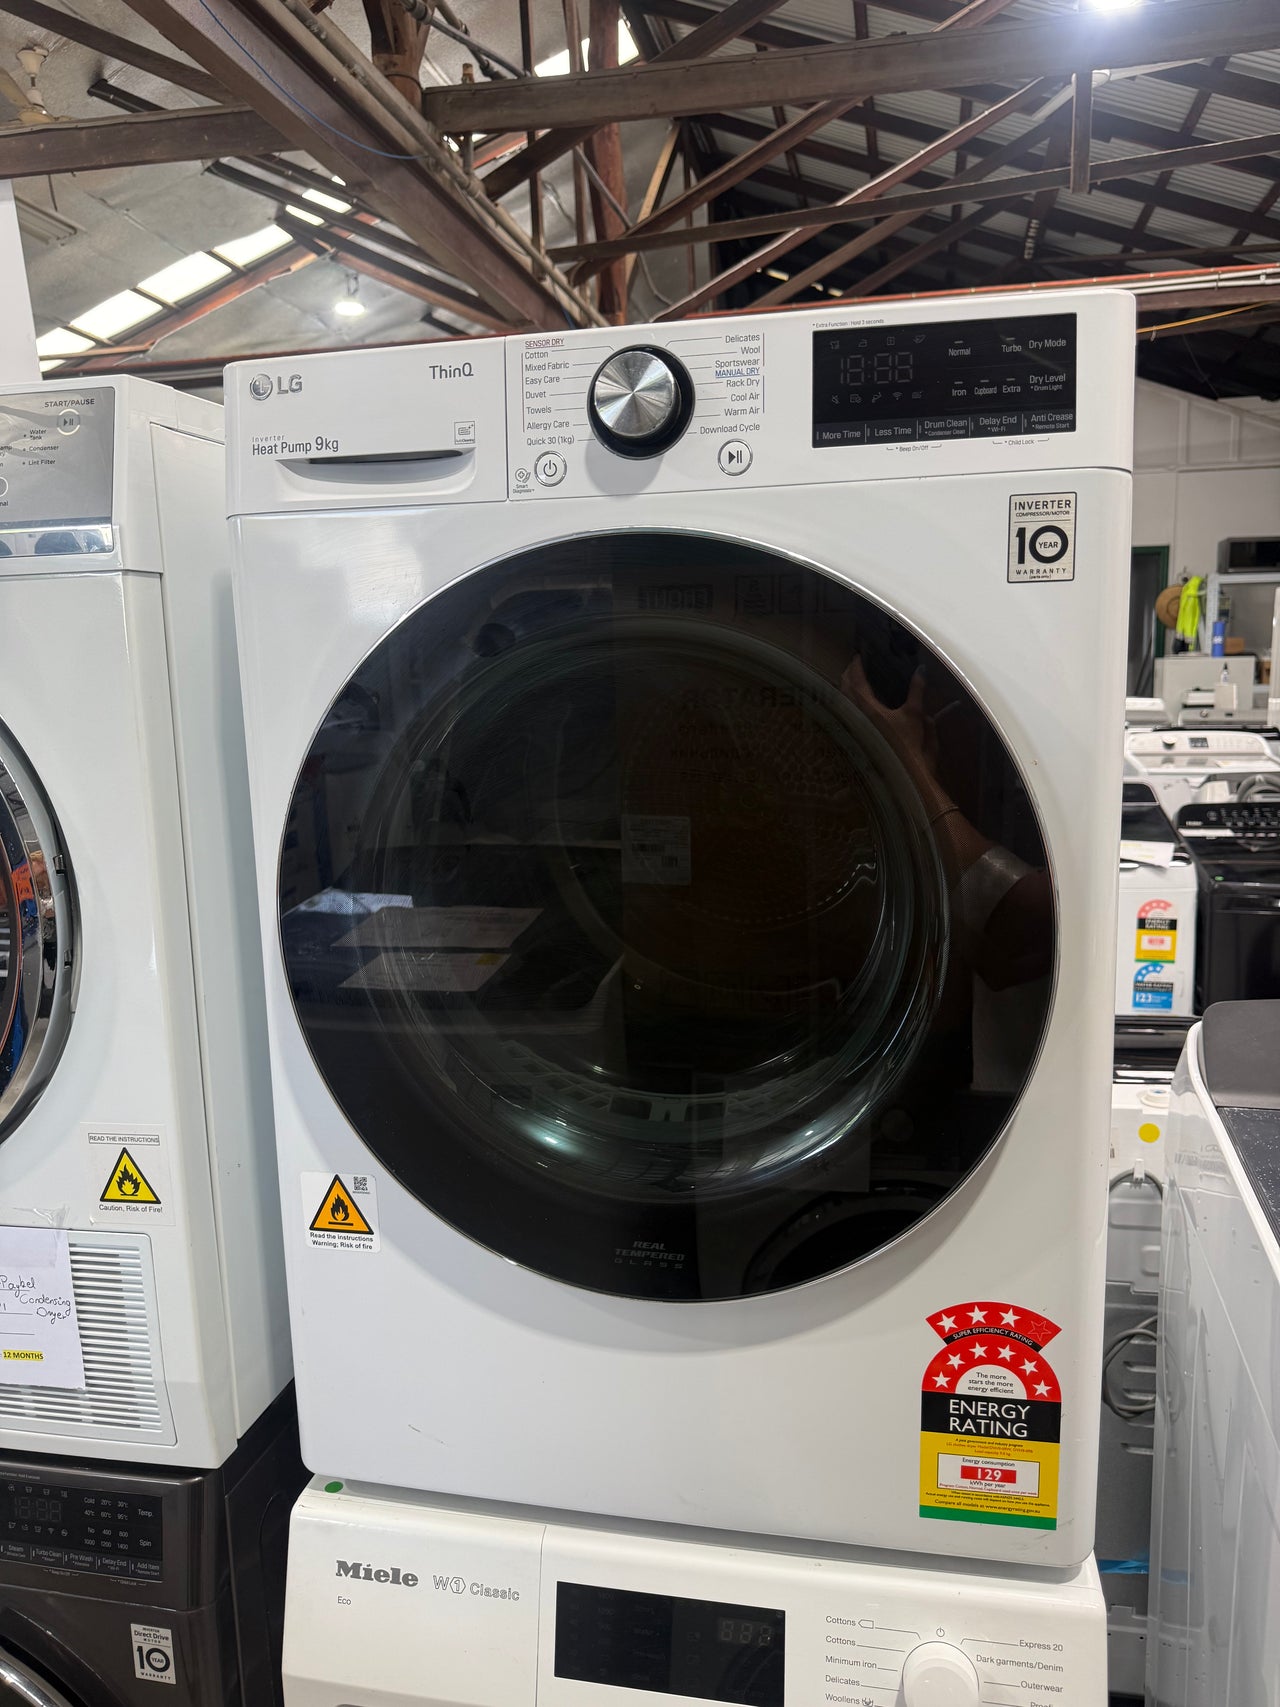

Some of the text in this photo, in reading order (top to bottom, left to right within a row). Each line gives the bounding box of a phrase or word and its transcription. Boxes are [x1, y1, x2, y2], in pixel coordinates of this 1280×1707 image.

[525, 338, 564, 348] SENSOR DRY
[725, 333, 760, 343] Delicates
[1001, 344, 1022, 353] Turbo
[1028, 338, 1067, 350] Dry Mode
[525, 351, 549, 360] Cotton
[741, 346, 761, 355] Wool
[949, 347, 971, 357] Normal
[525, 361, 570, 373] Mixed Fabric
[715, 358, 760, 369] Sportswear
[429, 362, 474, 380] ThinQ
[715, 367, 760, 378] MANUAL DRY
[525, 374, 560, 386] Easy Care
[726, 378, 760, 388] Rack Dry
[1029, 373, 1066, 384] Dry Level
[277, 374, 303, 395] LG
[1002, 385, 1021, 394] Extra
[525, 391, 546, 400] Duvet
[730, 392, 760, 402] Cool Air
[952, 389, 967, 397] Iron
[45, 398, 95, 408] START/PAUSE
[526, 406, 552, 415] Towels
[724, 406, 760, 417] Warm Air
[979, 415, 1017, 426] Delay End
[1030, 412, 1073, 423] Anti Crease
[526, 420, 570, 432] Allergy Care
[700, 422, 760, 435] Download Cycle
[924, 418, 968, 429] Drum Clean
[822, 430, 861, 440] More Time
[874, 427, 912, 437] Less Time
[252, 434, 285, 443] Inverter
[526, 435, 575, 446] Quick 30 (1kg)
[252, 436, 339, 456] Heat Pump 9kg
[1014, 500, 1071, 510] INVERTER
[1016, 525, 1069, 564] 10
[1038, 541, 1059, 549] YEAR
[99, 1204, 125, 1212] Caution,
[337, 1234, 374, 1242] instructions
[633, 1241, 666, 1250] REAL
[615, 1248, 686, 1261] TEMPERED
[20, 1294, 71, 1316] Condensing
[952, 1327, 1033, 1346] SUPER EFFICIENCY RATING
[13, 1352, 44, 1360] MONTHS
[984, 1379, 996, 1387] the
[967, 1386, 989, 1394] energy
[950, 1399, 1031, 1420] ENERGY
[949, 1416, 1028, 1438] RATING
[981, 1459, 1015, 1467] consumption
[977, 1468, 1002, 1480] 129
[139, 1539, 152, 1548] Spin
[102, 1557, 127, 1567] Delay End
[336, 1560, 419, 1587] Miele
[469, 1582, 520, 1601] Classic
[337, 1596, 352, 1606] Eco
[825, 1615, 856, 1627] Cottons
[134, 1630, 169, 1641] Direct Drive
[825, 1635, 856, 1646] Cottons
[1019, 1639, 1063, 1652] Express 20
[137, 1645, 171, 1673] 10
[825, 1655, 877, 1669] Minimum iron
[976, 1654, 1064, 1672] Dark garments/Denim
[825, 1674, 861, 1687] Delicates
[1020, 1680, 1064, 1693] Outerwear
[825, 1693, 861, 1705] Woollens
